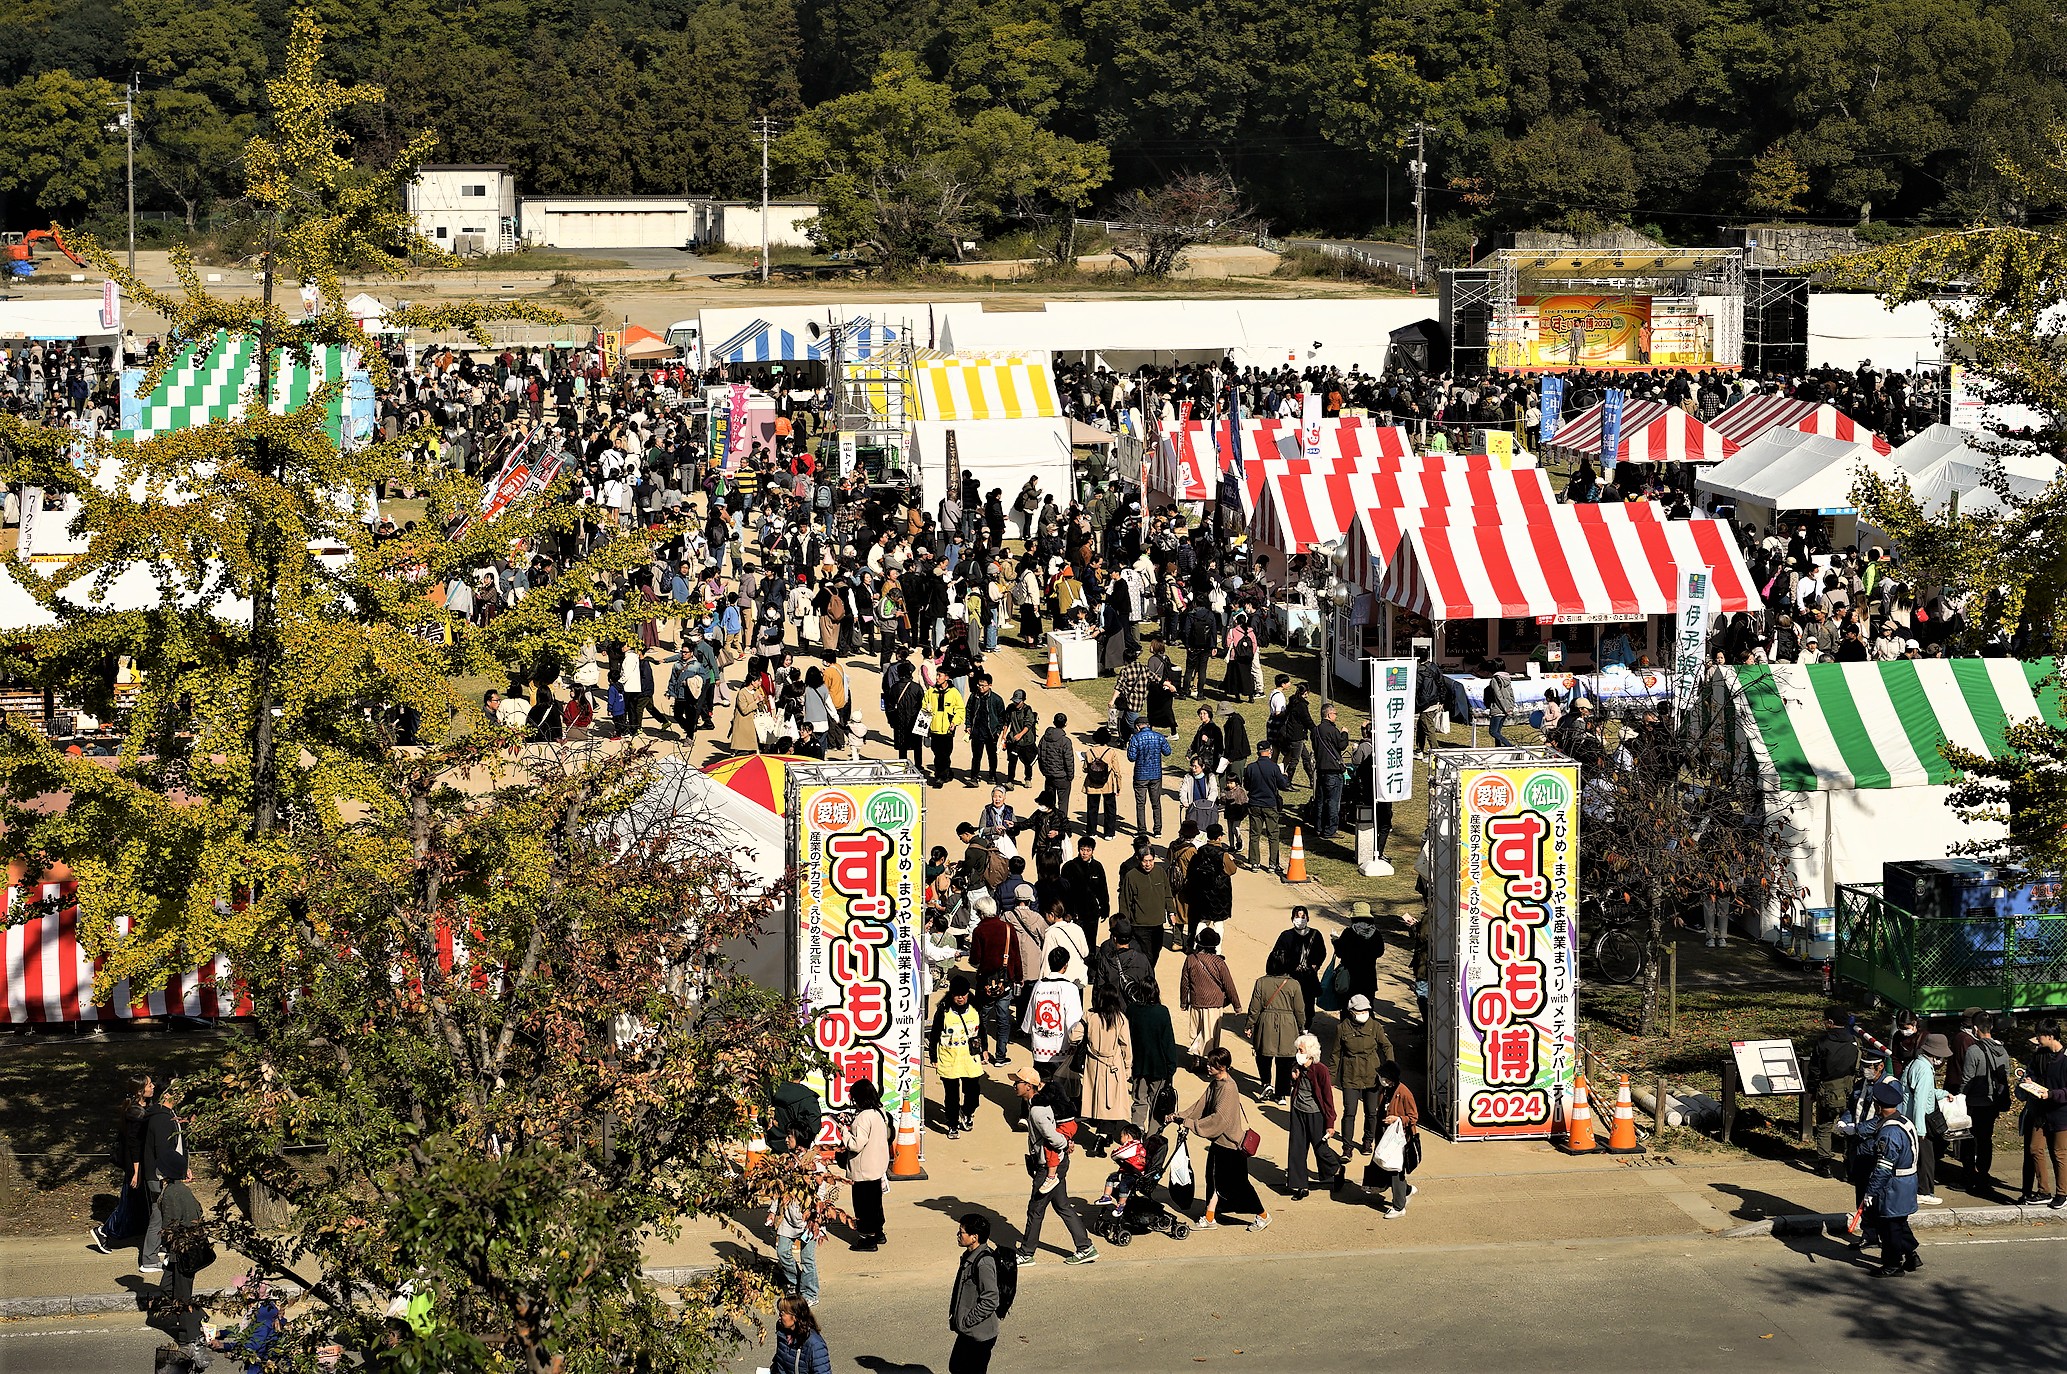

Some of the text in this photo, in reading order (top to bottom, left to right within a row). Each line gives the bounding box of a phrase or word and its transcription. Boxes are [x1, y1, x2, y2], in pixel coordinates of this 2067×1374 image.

[1386, 697, 1405, 794] 伊予銀行
[1476, 785, 1508, 807] 愛媛
[1531, 783, 1562, 806] 松山
[817, 802, 849, 824] 愛媛
[874, 801, 906, 824] 松山
[1553, 810, 1567, 992] えひめ・まつやま産業まつり
[898, 828, 912, 1013] えひめ・まつやま産業まつり
[1478, 818, 1542, 1080] すごいもの博
[1551, 994, 1569, 1004] with
[895, 1015, 914, 1025] with
[1477, 1097, 1541, 1119] 2024
